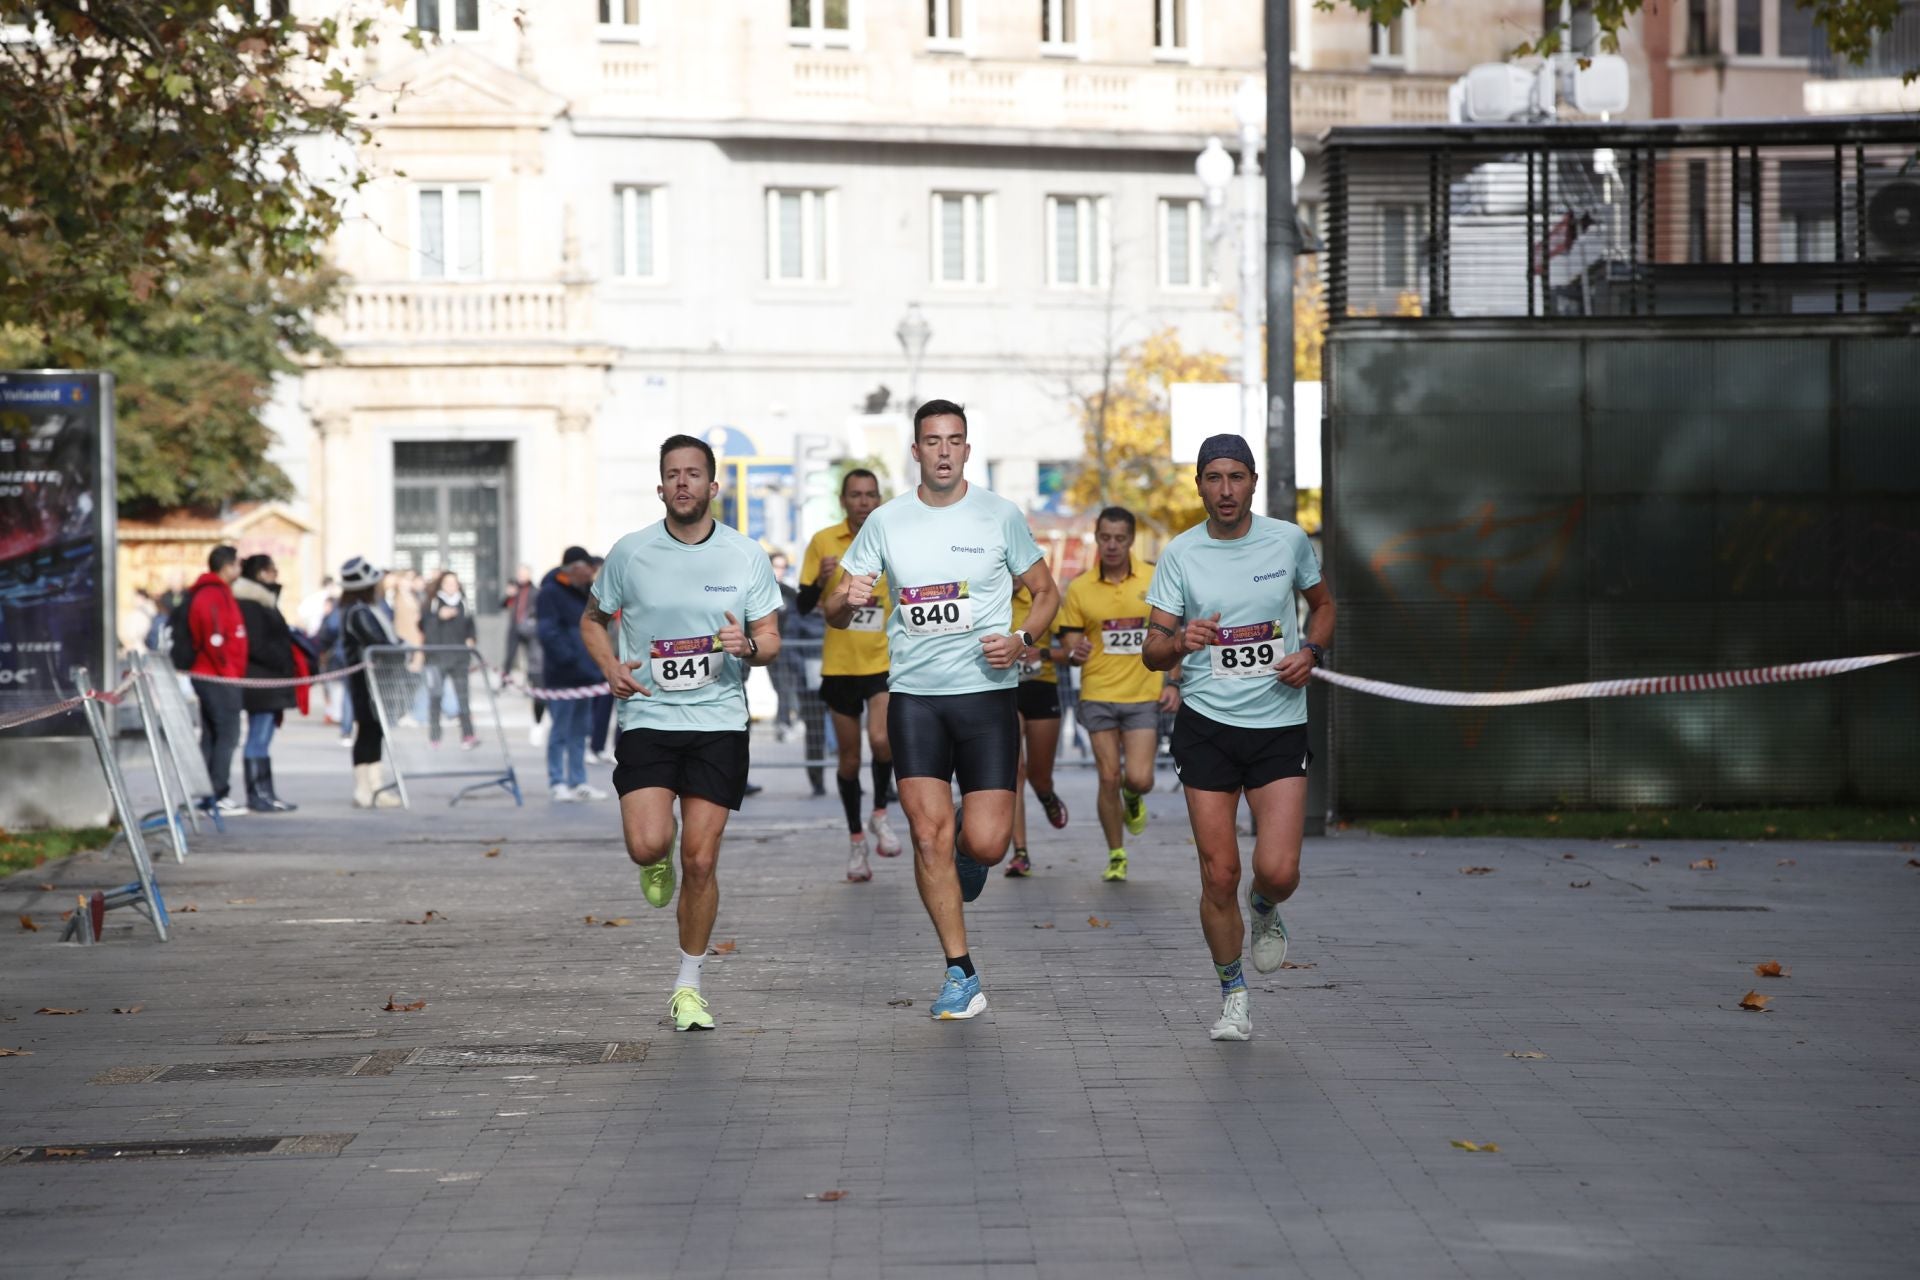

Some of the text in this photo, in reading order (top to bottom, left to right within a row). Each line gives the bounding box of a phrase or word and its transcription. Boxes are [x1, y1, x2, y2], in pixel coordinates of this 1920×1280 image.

[4, 389, 60, 401] Valladolid
[951, 545, 985, 554] OneHealth
[1253, 569, 1287, 583] OneHealth
[704, 585, 737, 593] OneHealth
[911, 602, 959, 626] 840
[1110, 632, 1142, 646] 228
[1221, 644, 1274, 668] 839
[662, 656, 709, 680] 841
